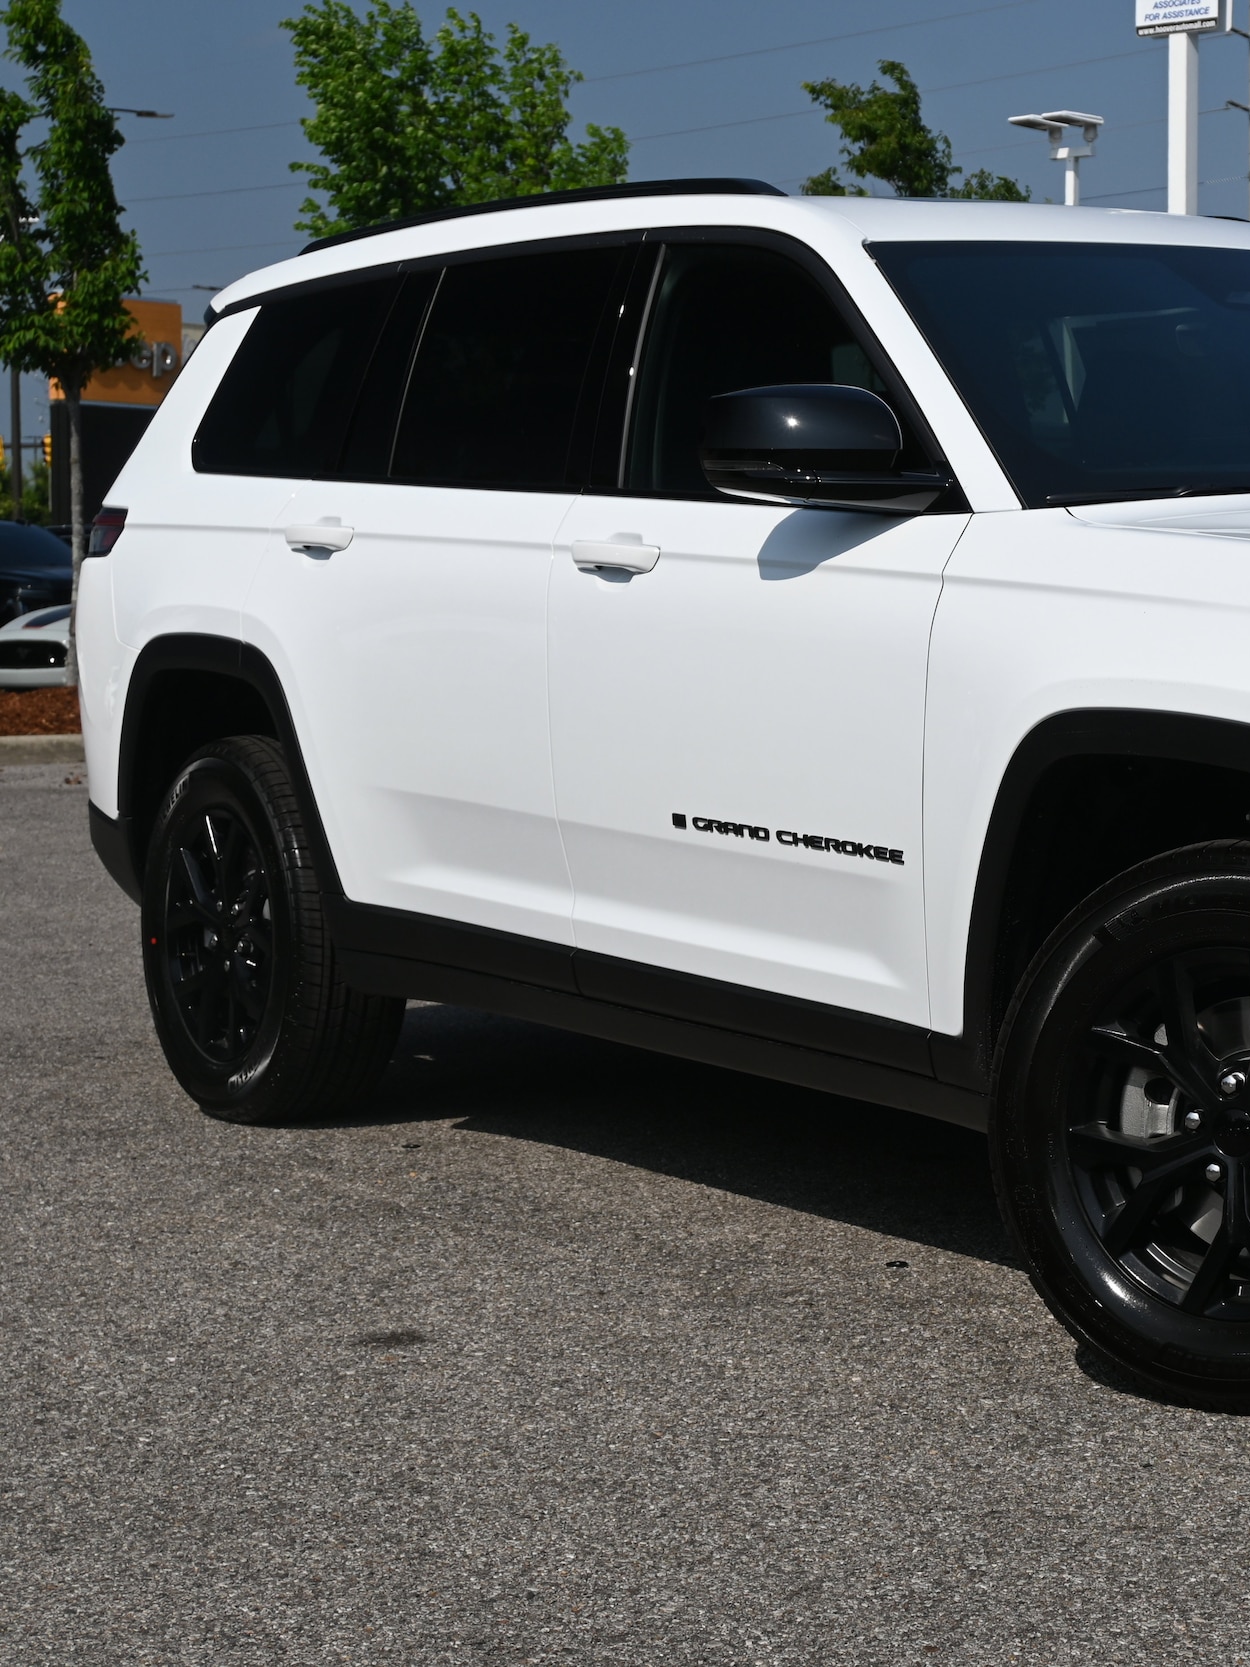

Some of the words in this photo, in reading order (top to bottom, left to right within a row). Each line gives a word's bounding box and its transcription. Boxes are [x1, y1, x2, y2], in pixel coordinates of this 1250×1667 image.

[1145, 13, 1160, 22] FOR
[1161, 7, 1210, 19] ASSISTANCE
[1138, 20, 1216, 35] www.hooverautomall.com
[692, 816, 770, 842] GRAND
[775, 830, 905, 866] CHEROKEE
